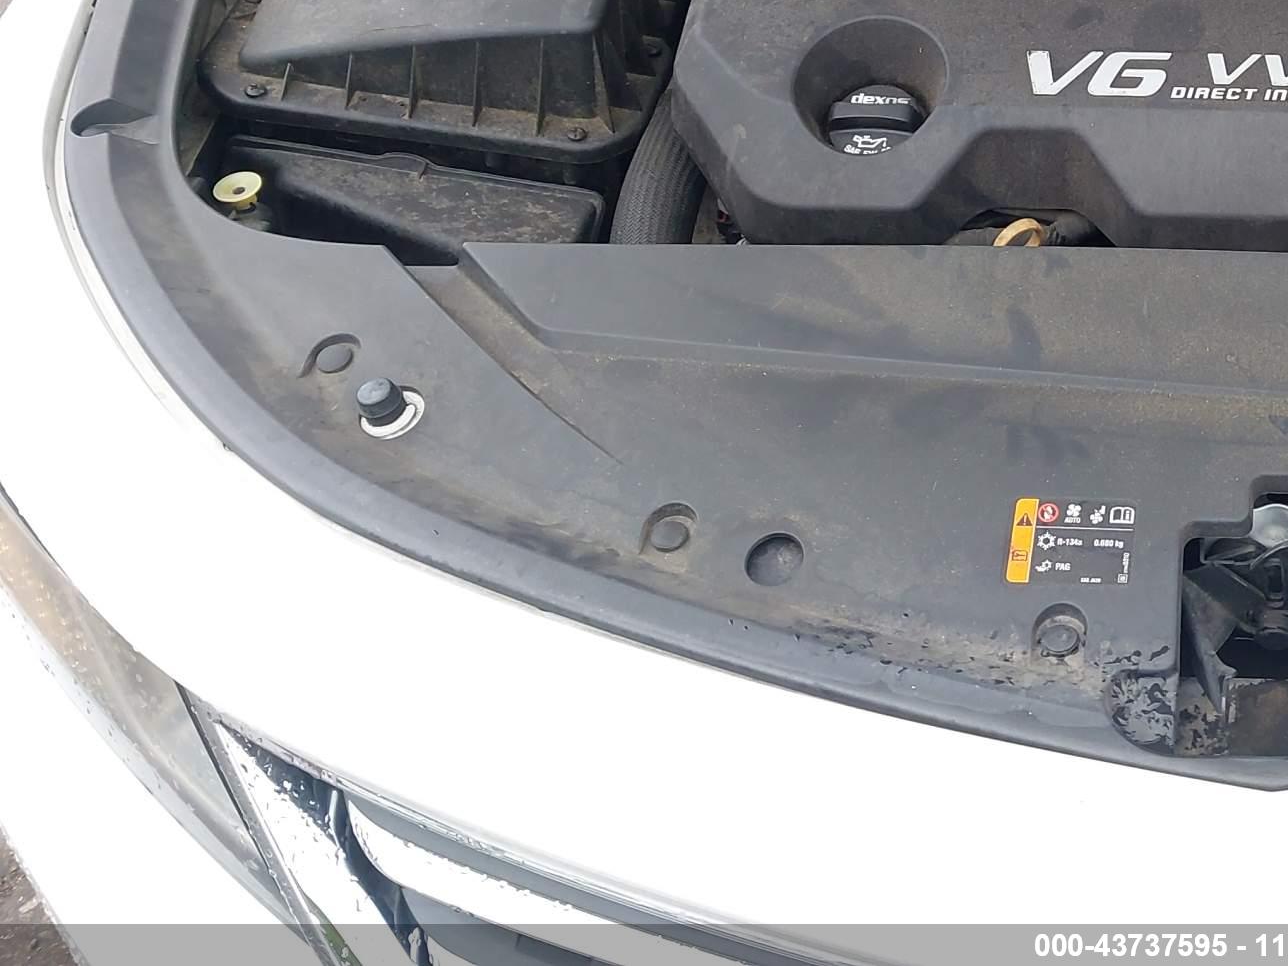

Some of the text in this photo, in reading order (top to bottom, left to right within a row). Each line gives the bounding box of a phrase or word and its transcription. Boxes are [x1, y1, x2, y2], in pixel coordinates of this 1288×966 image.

[1026, 50, 1172, 97] V6
[1170, 86, 1258, 102] DIRECT
[1055, 562, 1071, 571] PAG
